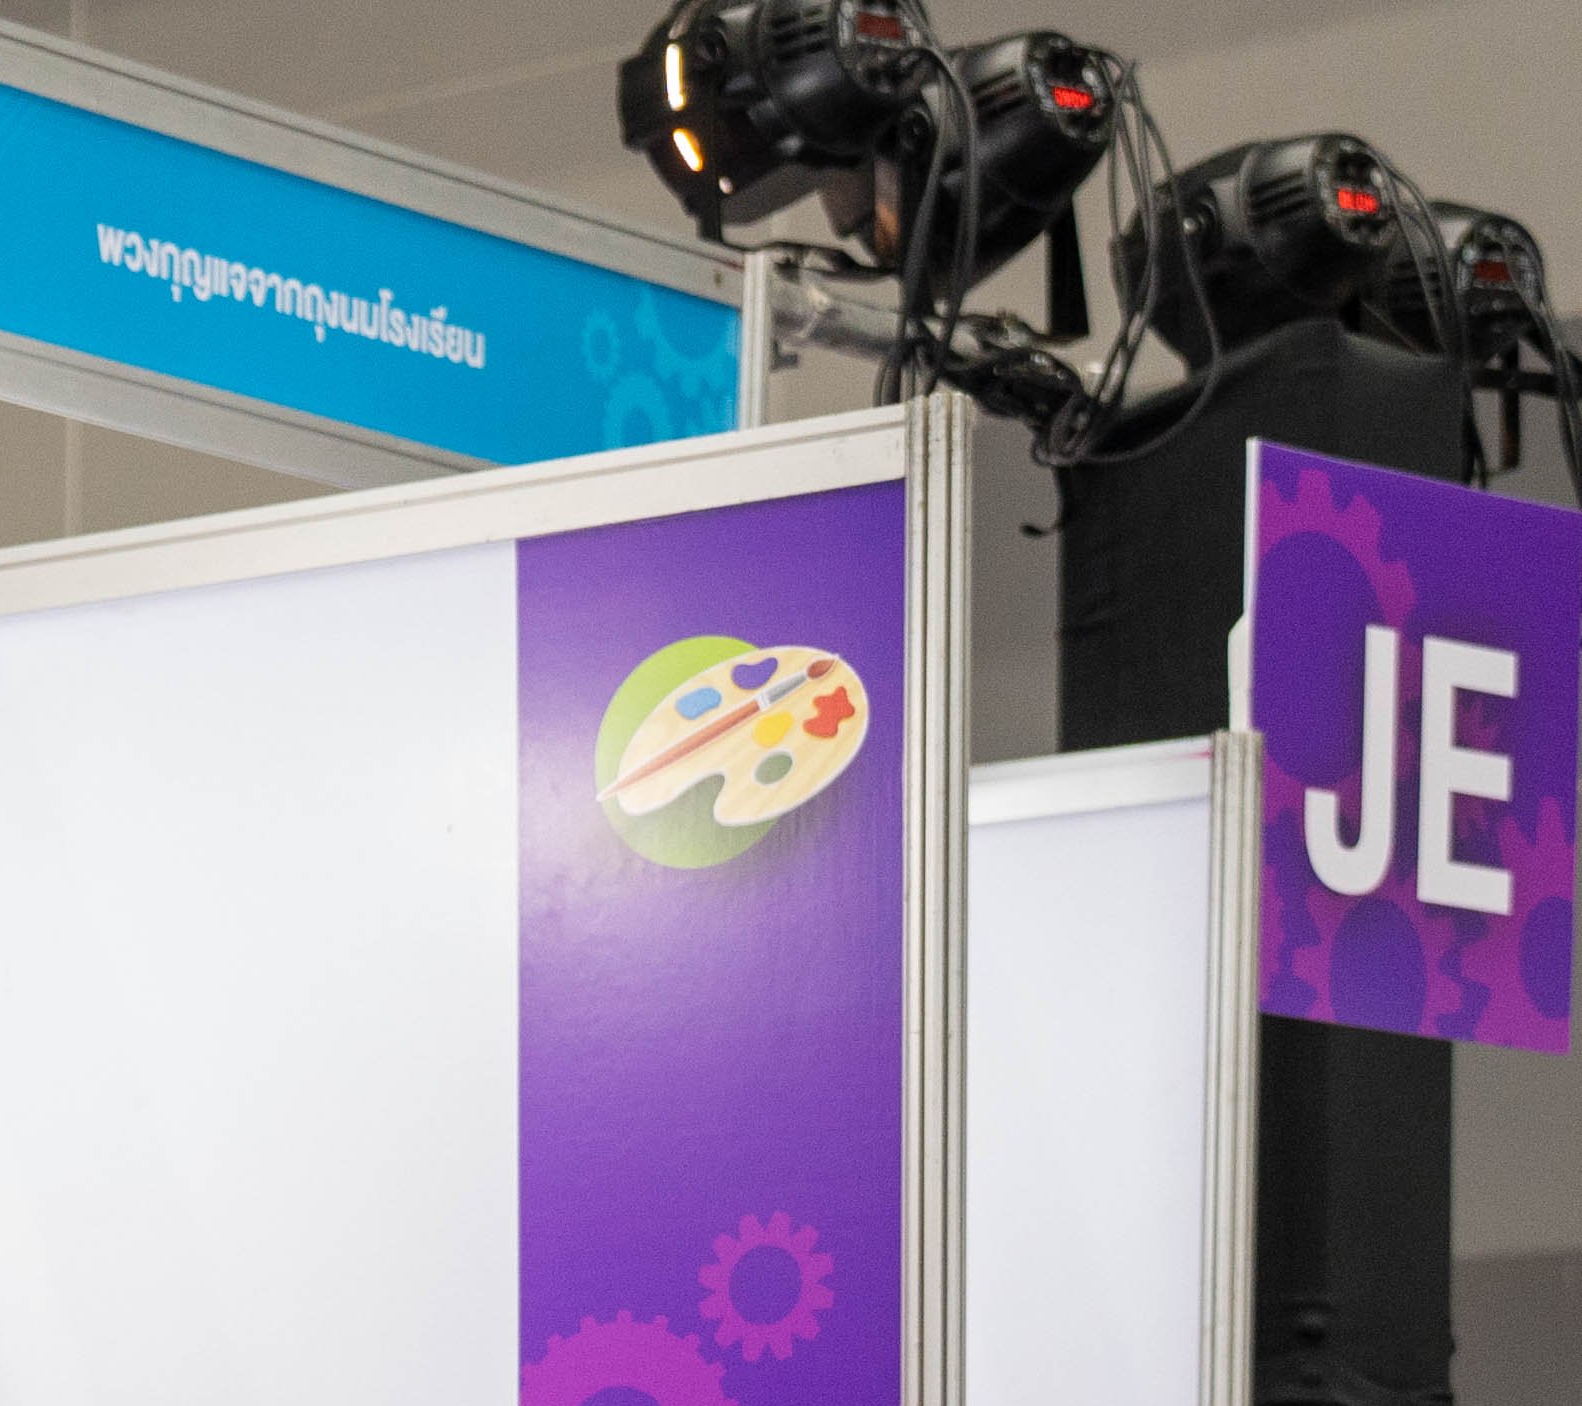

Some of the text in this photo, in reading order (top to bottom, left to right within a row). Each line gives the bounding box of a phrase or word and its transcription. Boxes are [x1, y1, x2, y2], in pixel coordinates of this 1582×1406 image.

[97, 223, 484, 369] พวงกุญแจจากถุงนมโรงเรียน
[1304, 624, 1518, 917] JE
